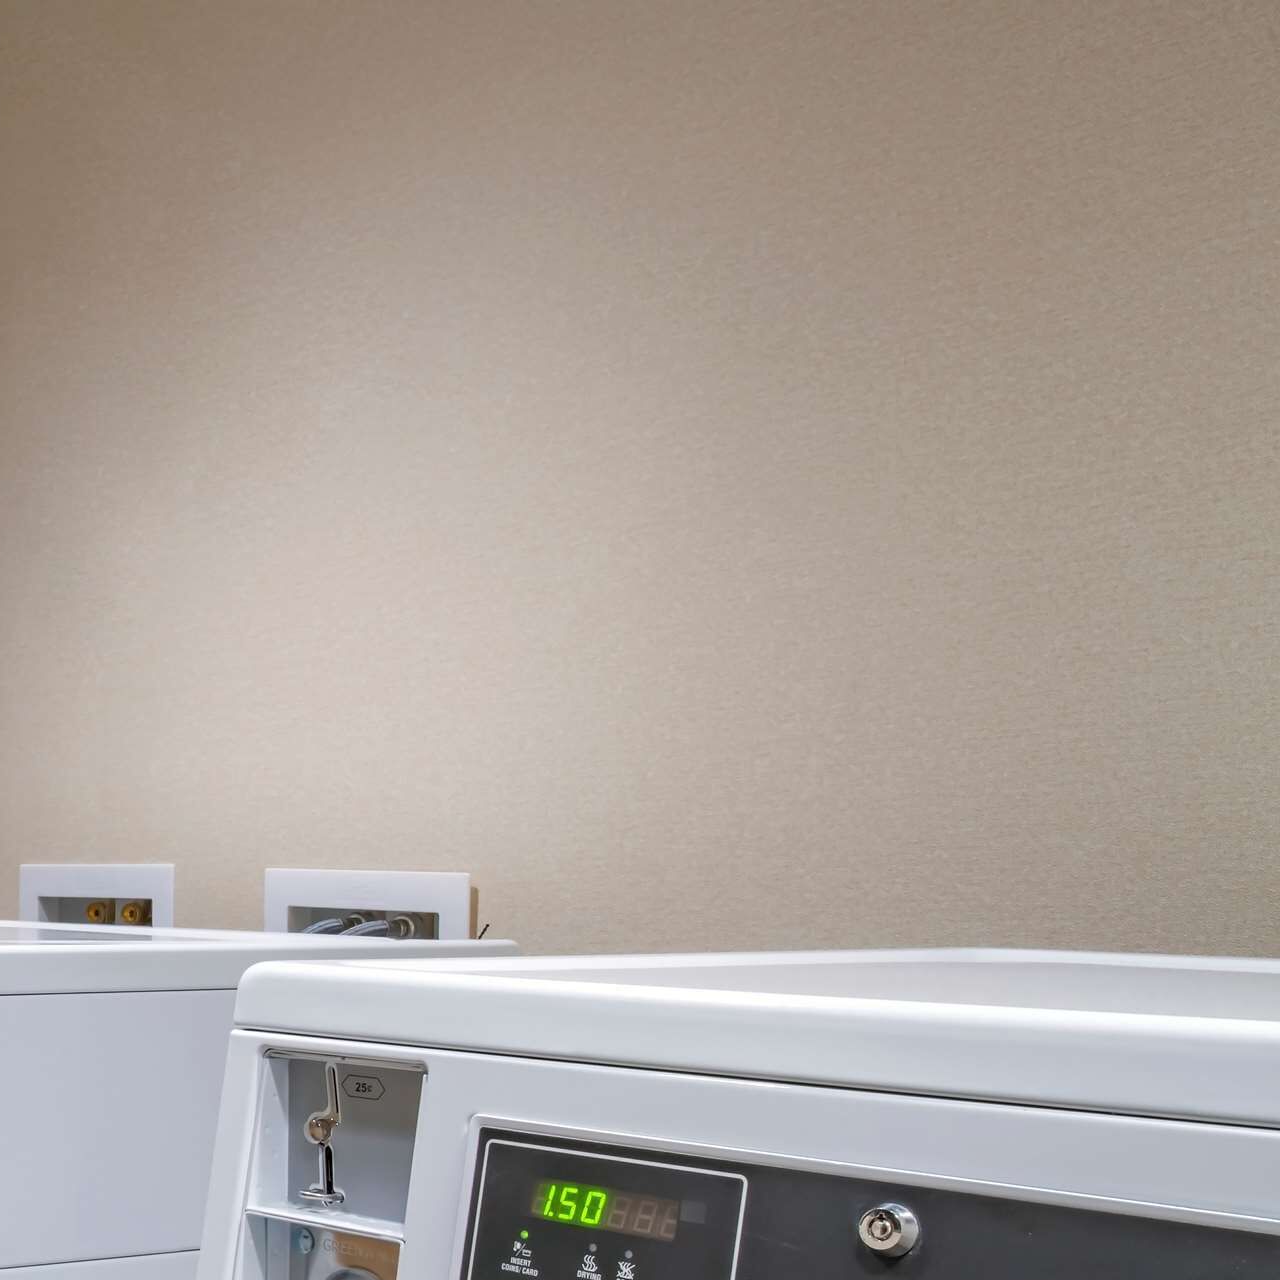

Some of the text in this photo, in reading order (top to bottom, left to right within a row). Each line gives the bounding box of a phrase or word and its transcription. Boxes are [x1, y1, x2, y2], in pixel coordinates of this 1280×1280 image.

[543, 1185, 607, 1225] 1.50
[510, 1256, 532, 1267] INSERT
[521, 1267, 539, 1278] CARD
